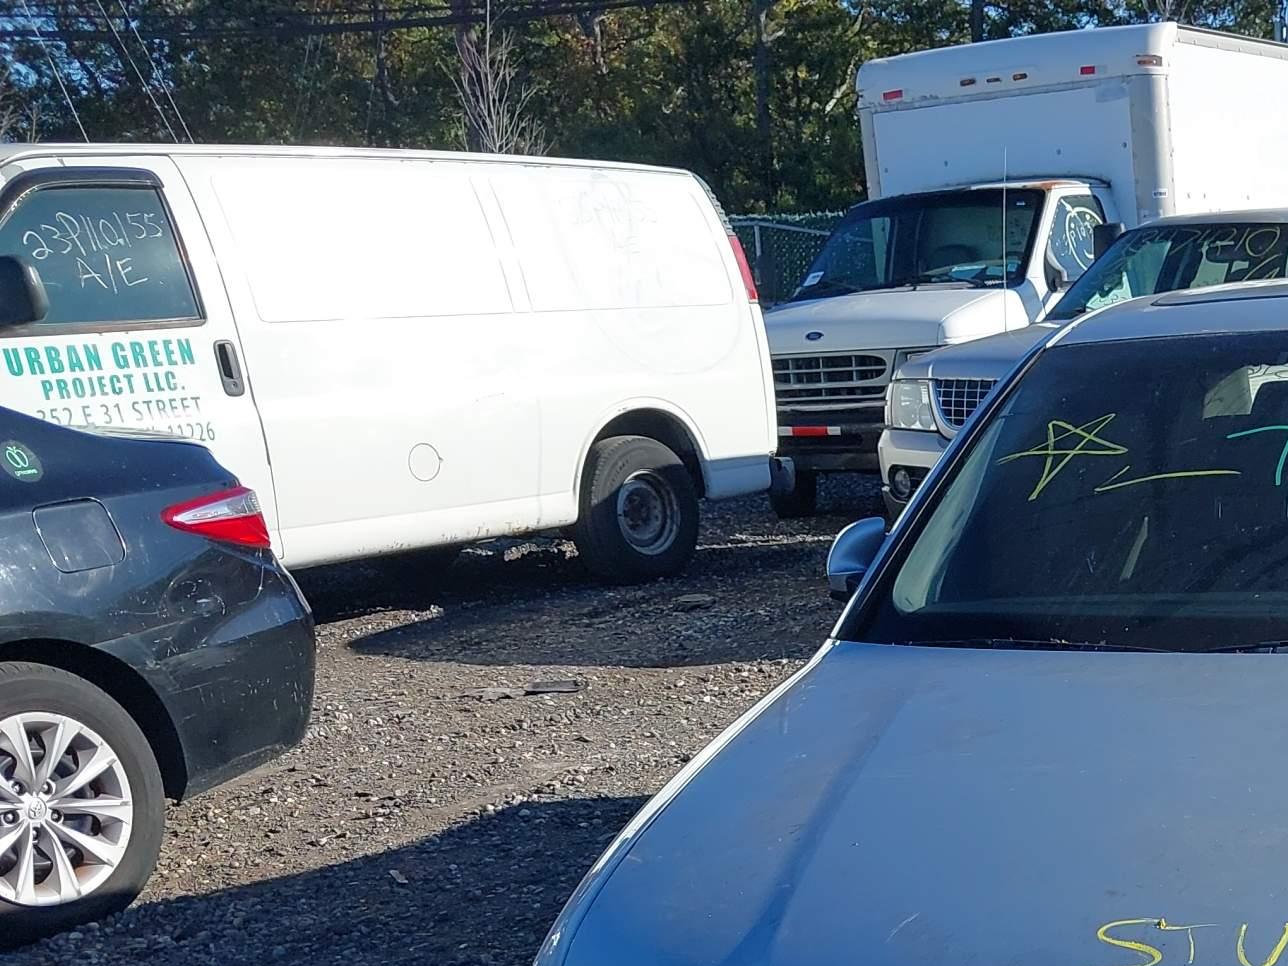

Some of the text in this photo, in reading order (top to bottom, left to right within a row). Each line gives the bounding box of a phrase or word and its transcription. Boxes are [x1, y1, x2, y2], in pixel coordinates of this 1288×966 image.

[2, 338, 196, 377] URBAN GREEN
[40, 370, 186, 401] PROJECT LLC.
[82, 404, 93, 426] E
[100, 402, 125, 425] 31
[131, 397, 201, 421] STREET
